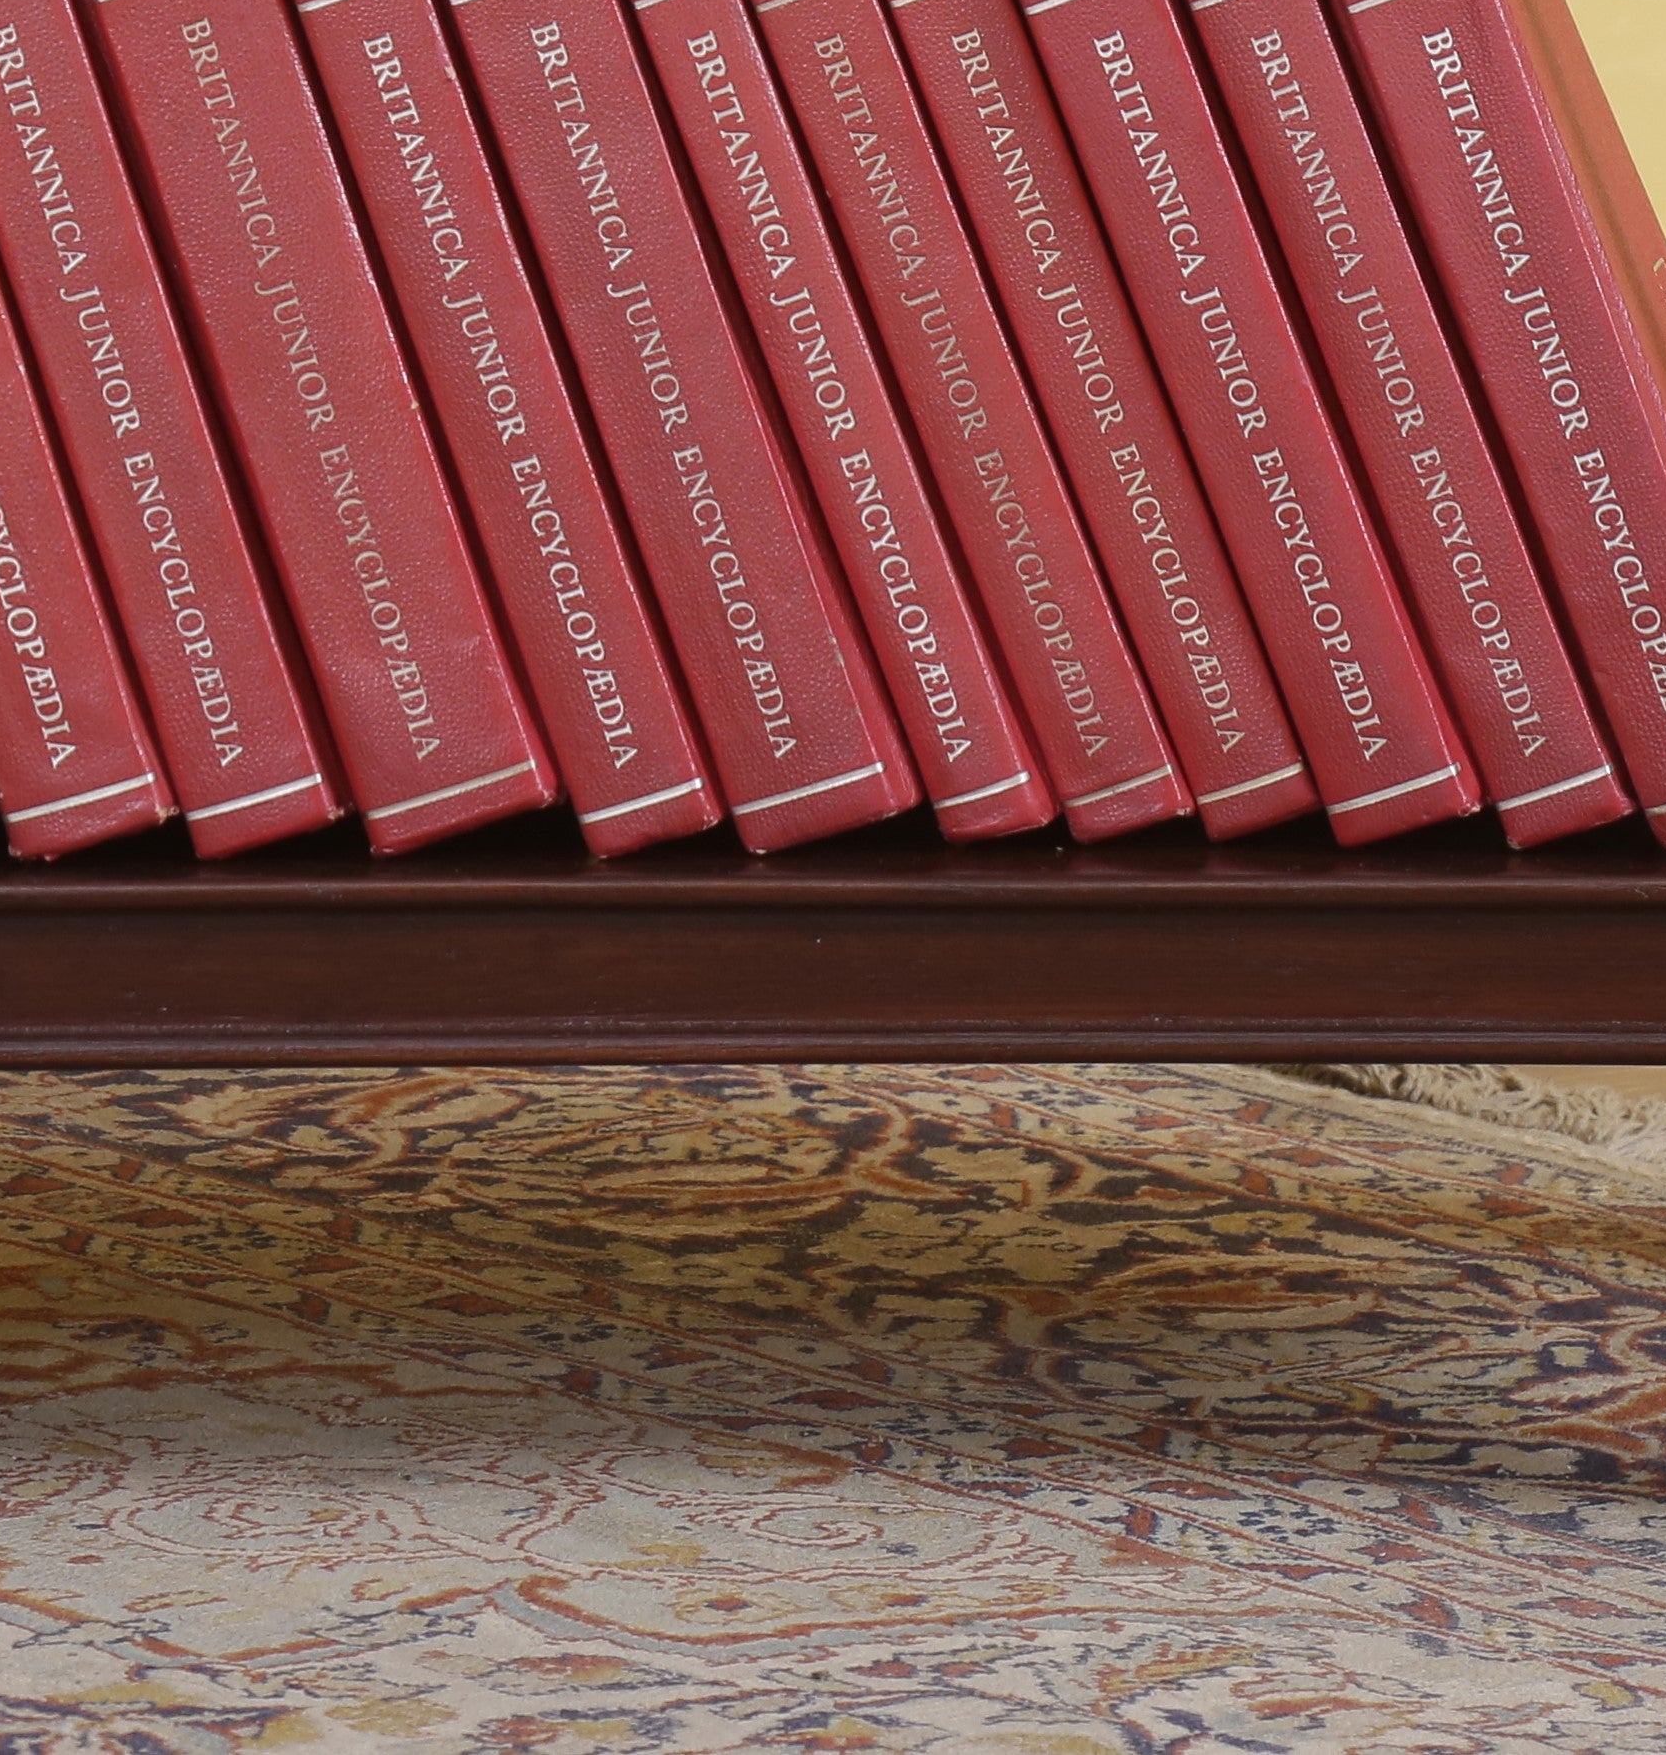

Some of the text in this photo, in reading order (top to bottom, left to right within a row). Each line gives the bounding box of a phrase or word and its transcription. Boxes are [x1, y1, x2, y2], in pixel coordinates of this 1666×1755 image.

[60, 286, 140, 439] JUNIOR
[124, 451, 243, 767] ENCYCLOPÆDIA
[181, 18, 440, 761] BRITANNICA JUNIOR ENCYCLOPÆDIA
[363, 32, 638, 769] BRITANNICA JUNIOR ENCYCLOPÆDIA
[530, 21, 797, 759] BRITANNICA JUNIOR ENCYCLOPÆDIA
[687, 30, 972, 763] BRITANNICA JUNIOR ENCYCLOPÆDIA
[814, 34, 1109, 757] BRITANNICA JUNIOR ENCYCLOPÆDIA
[951, 28, 1246, 753] BRITANNICA JUNIOR ENCYCLOPÆDIA
[1093, 30, 1387, 761] BRITANNICA JUNIOR ENCYCLOPÆDIA
[1250, 29, 1547, 757] BRITANNICA JUNIOR ENCYCLOPÆDIA
[1422, 27, 1530, 277] BRITANNICA
[1504, 287, 1589, 440] JUNIOR
